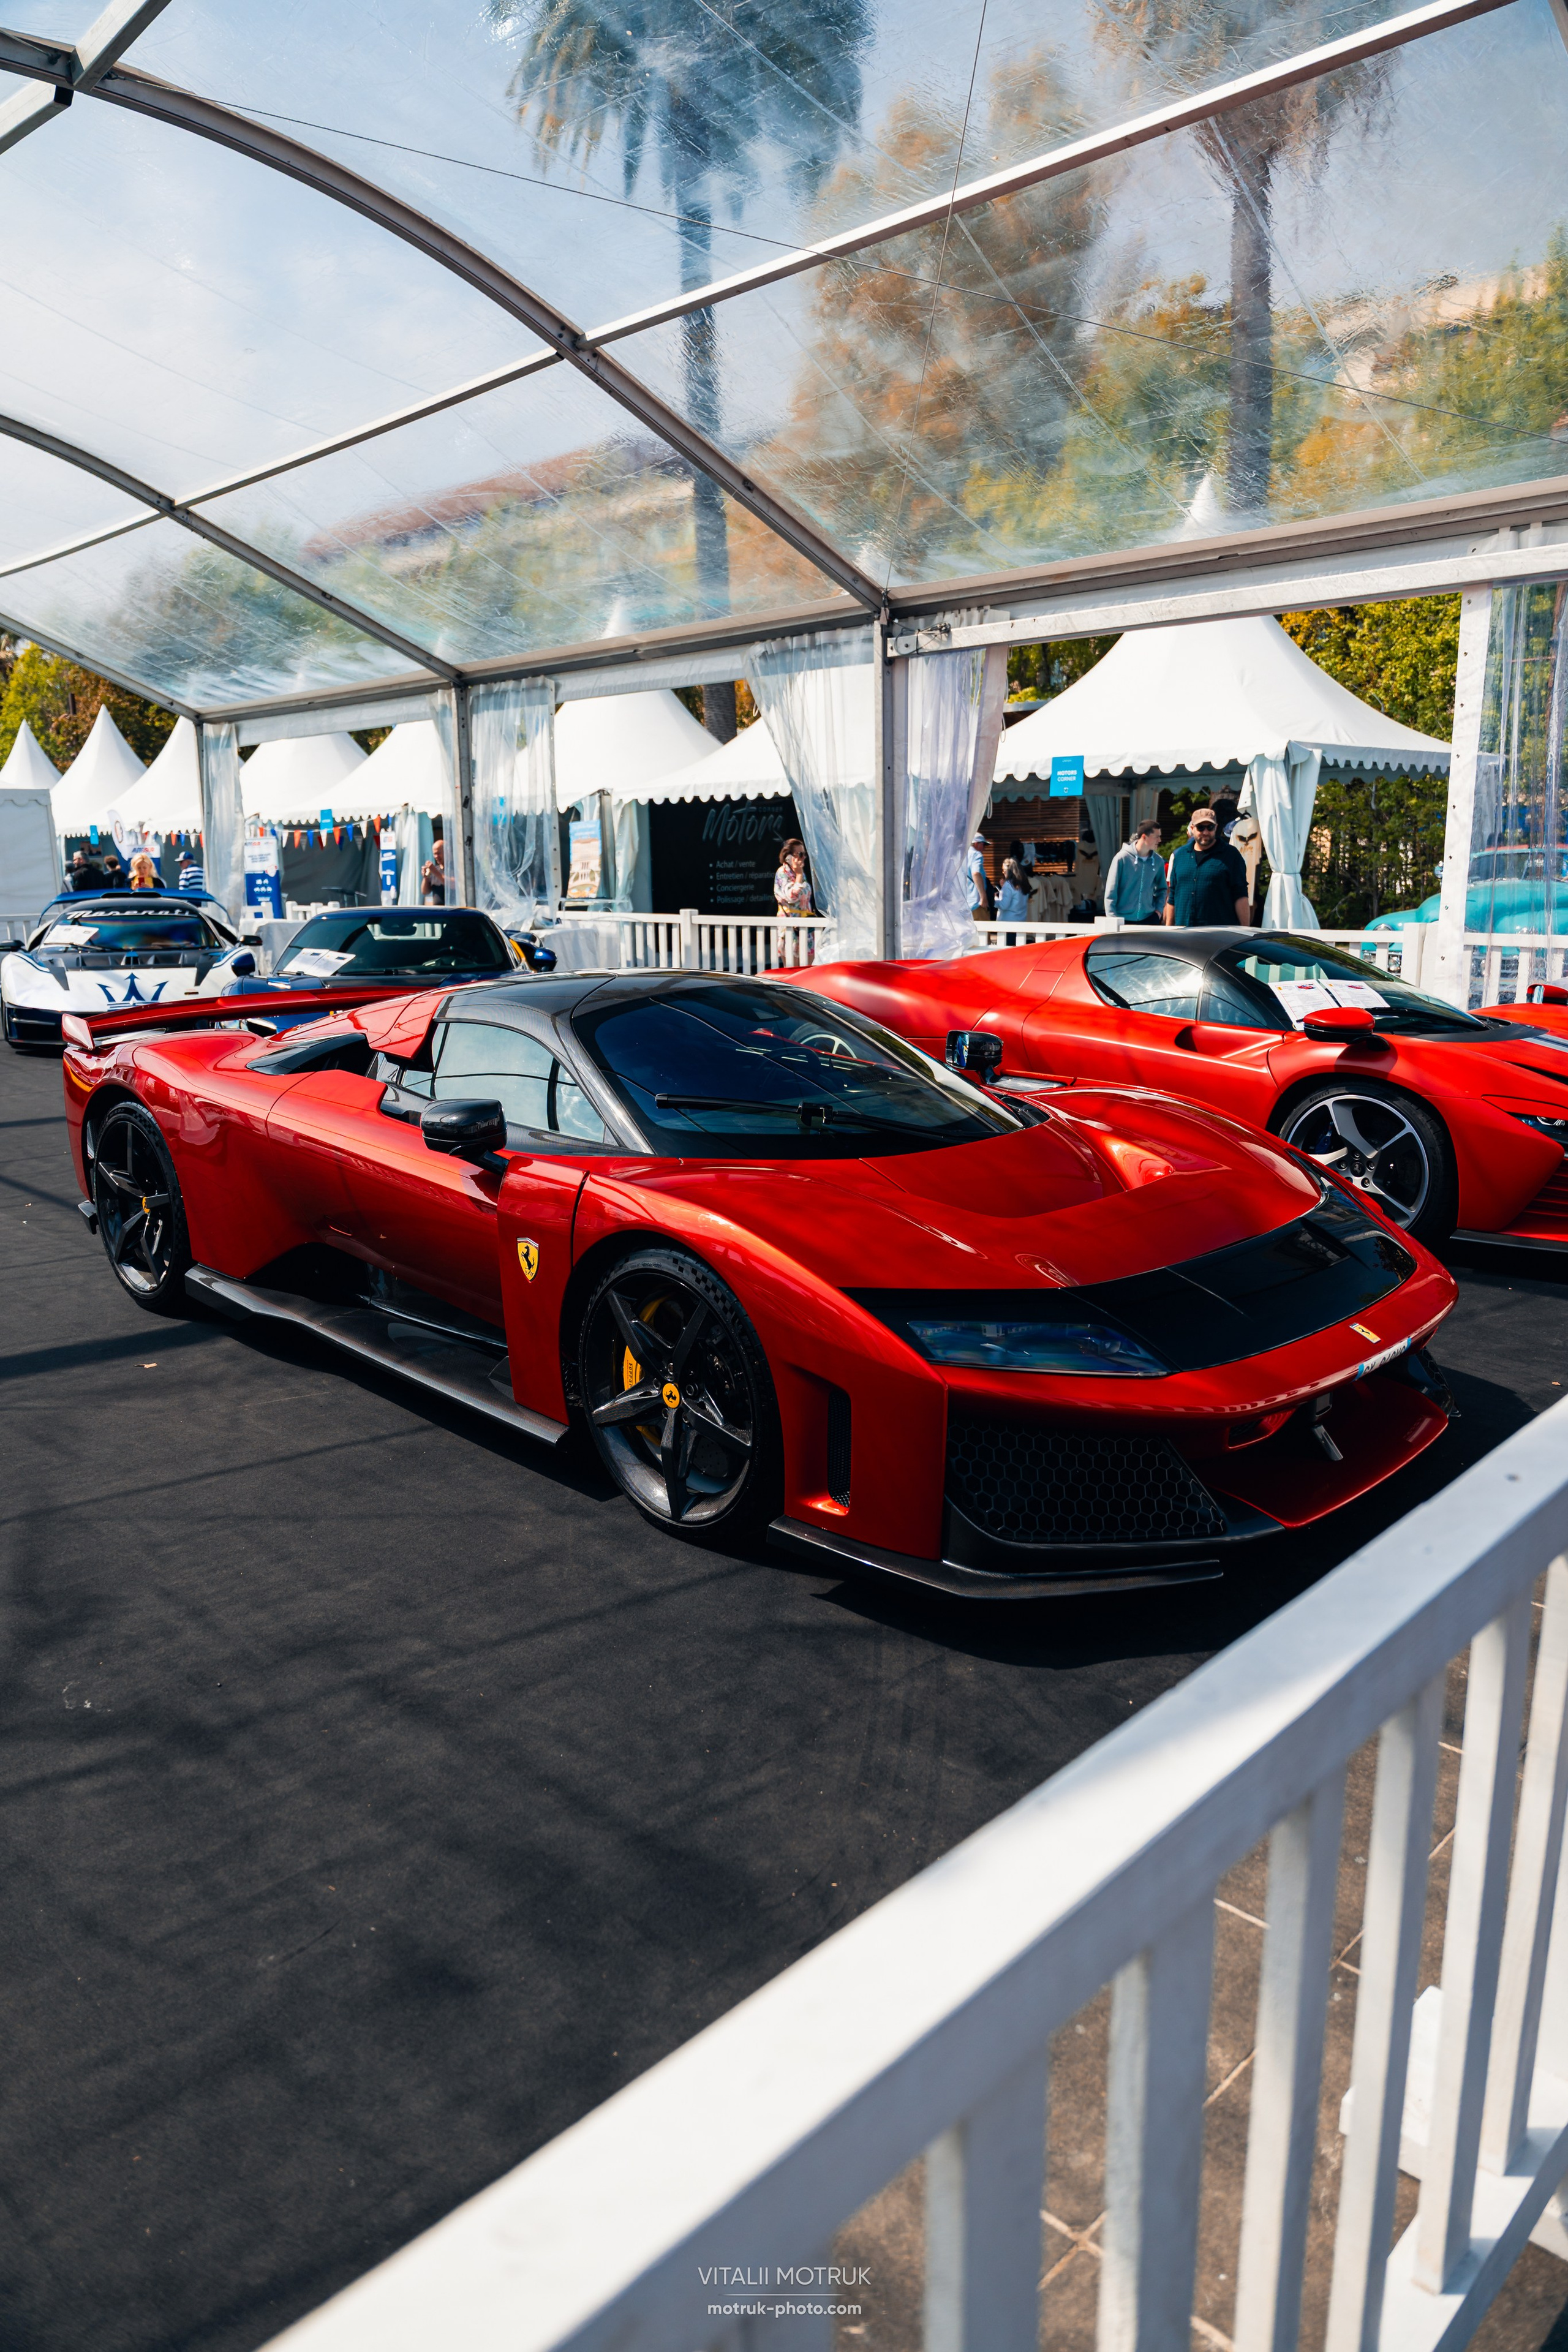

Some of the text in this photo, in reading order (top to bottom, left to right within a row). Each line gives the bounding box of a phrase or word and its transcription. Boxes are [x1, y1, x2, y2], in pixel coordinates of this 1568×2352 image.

[703, 800, 784, 847] Motors
[715, 860, 734, 869] Achat
[748, 870, 775, 880] réparatio
[716, 883, 755, 892] Conciergerie
[717, 895, 745, 905] Polissage
[66, 909, 198, 919] Maserati
